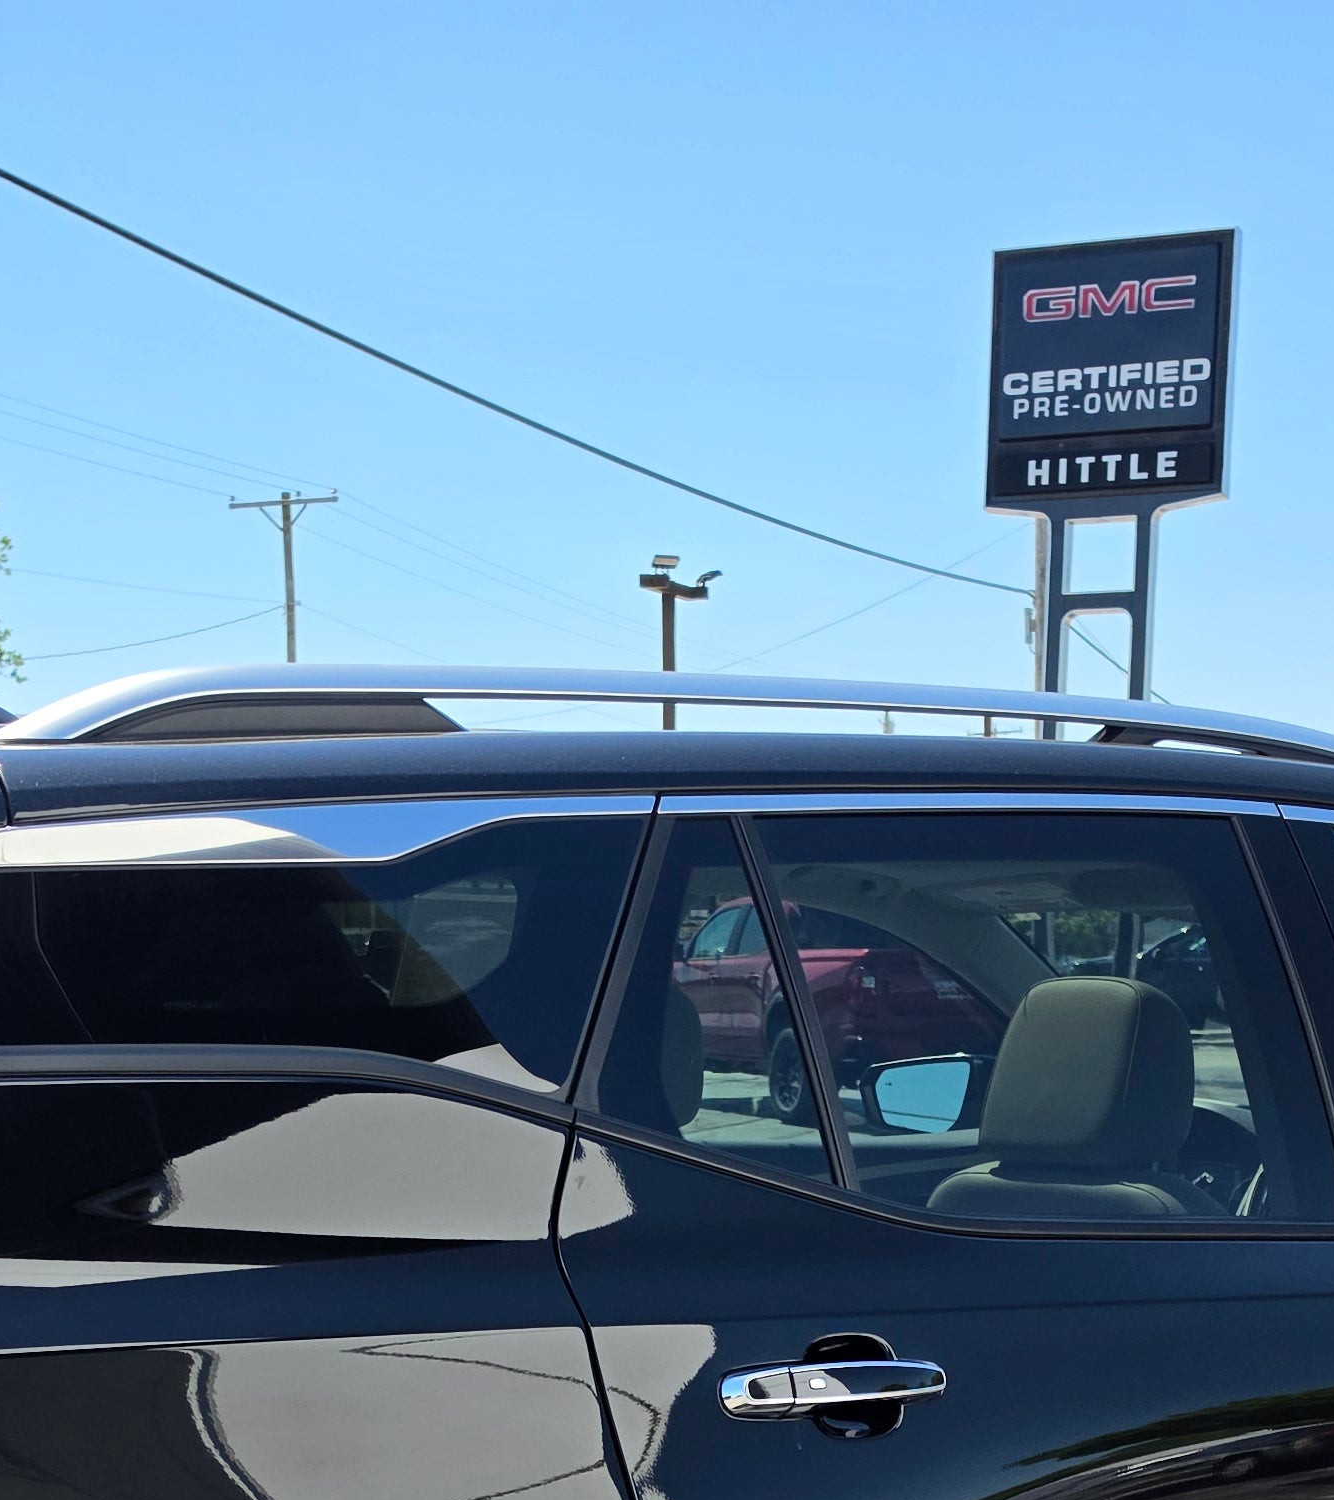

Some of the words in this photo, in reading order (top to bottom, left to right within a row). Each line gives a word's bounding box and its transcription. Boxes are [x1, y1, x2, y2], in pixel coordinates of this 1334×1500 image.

[1022, 275, 1196, 322] GMC
[1002, 357, 1211, 396] CERTIFIED
[1013, 385, 1197, 419] PRE-OWNED
[1027, 451, 1178, 486] HITTLE
